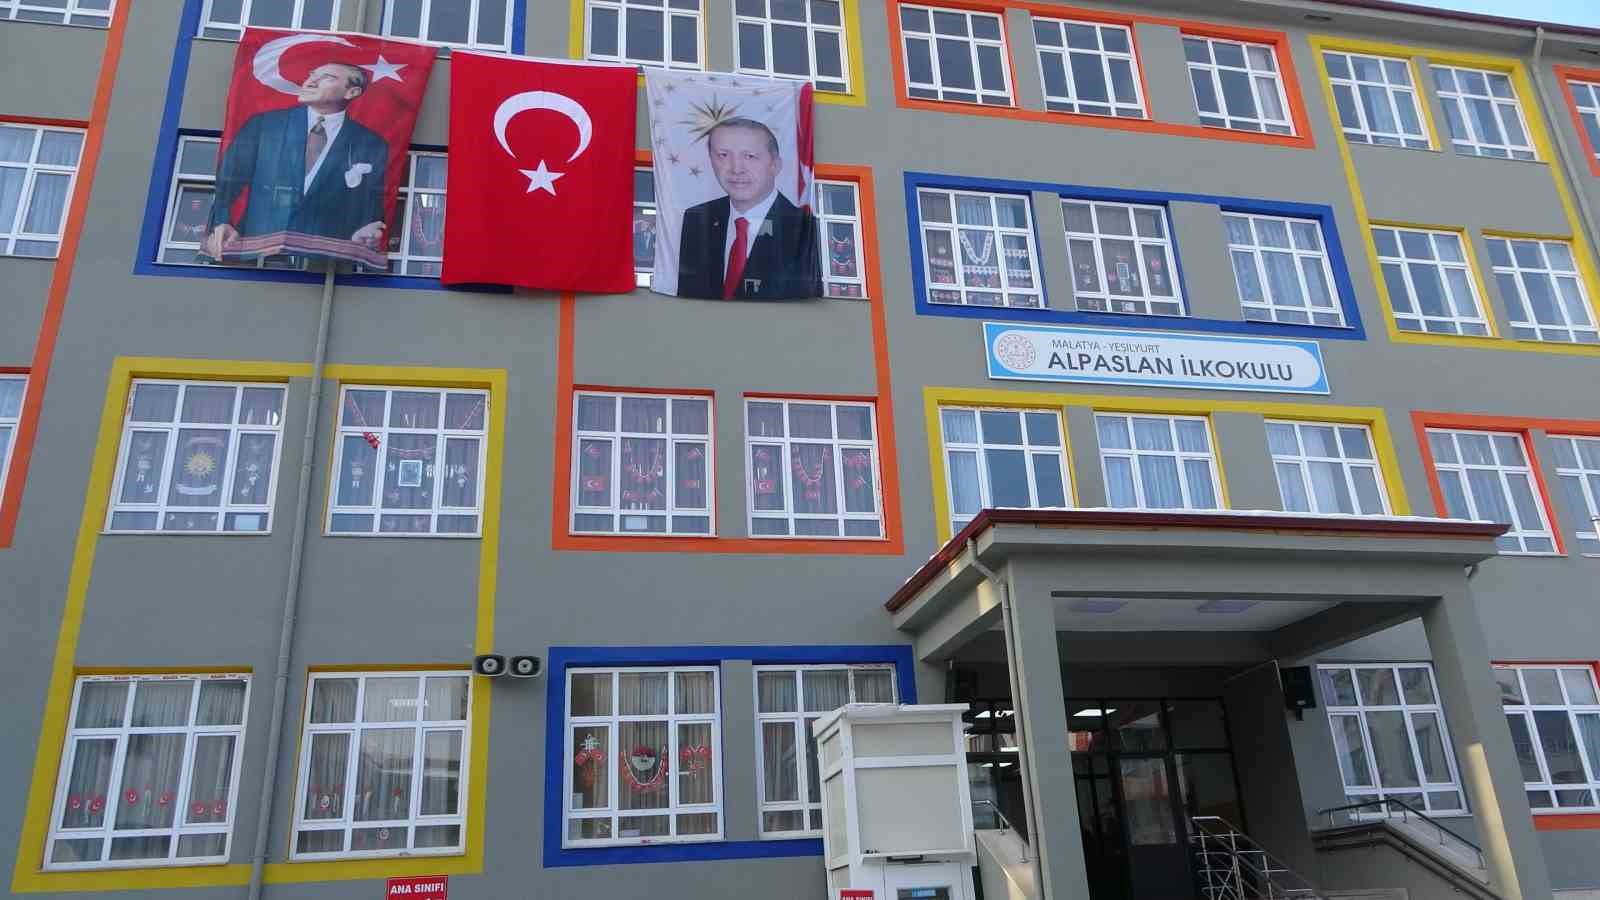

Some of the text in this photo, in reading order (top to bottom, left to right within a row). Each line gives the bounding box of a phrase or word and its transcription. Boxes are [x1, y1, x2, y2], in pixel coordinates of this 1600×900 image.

[1051, 339, 1100, 350] MALATYA
[1048, 352, 1292, 381] ALPASLAN İLKOKULU
[390, 883, 444, 894] ANA SINIFI
